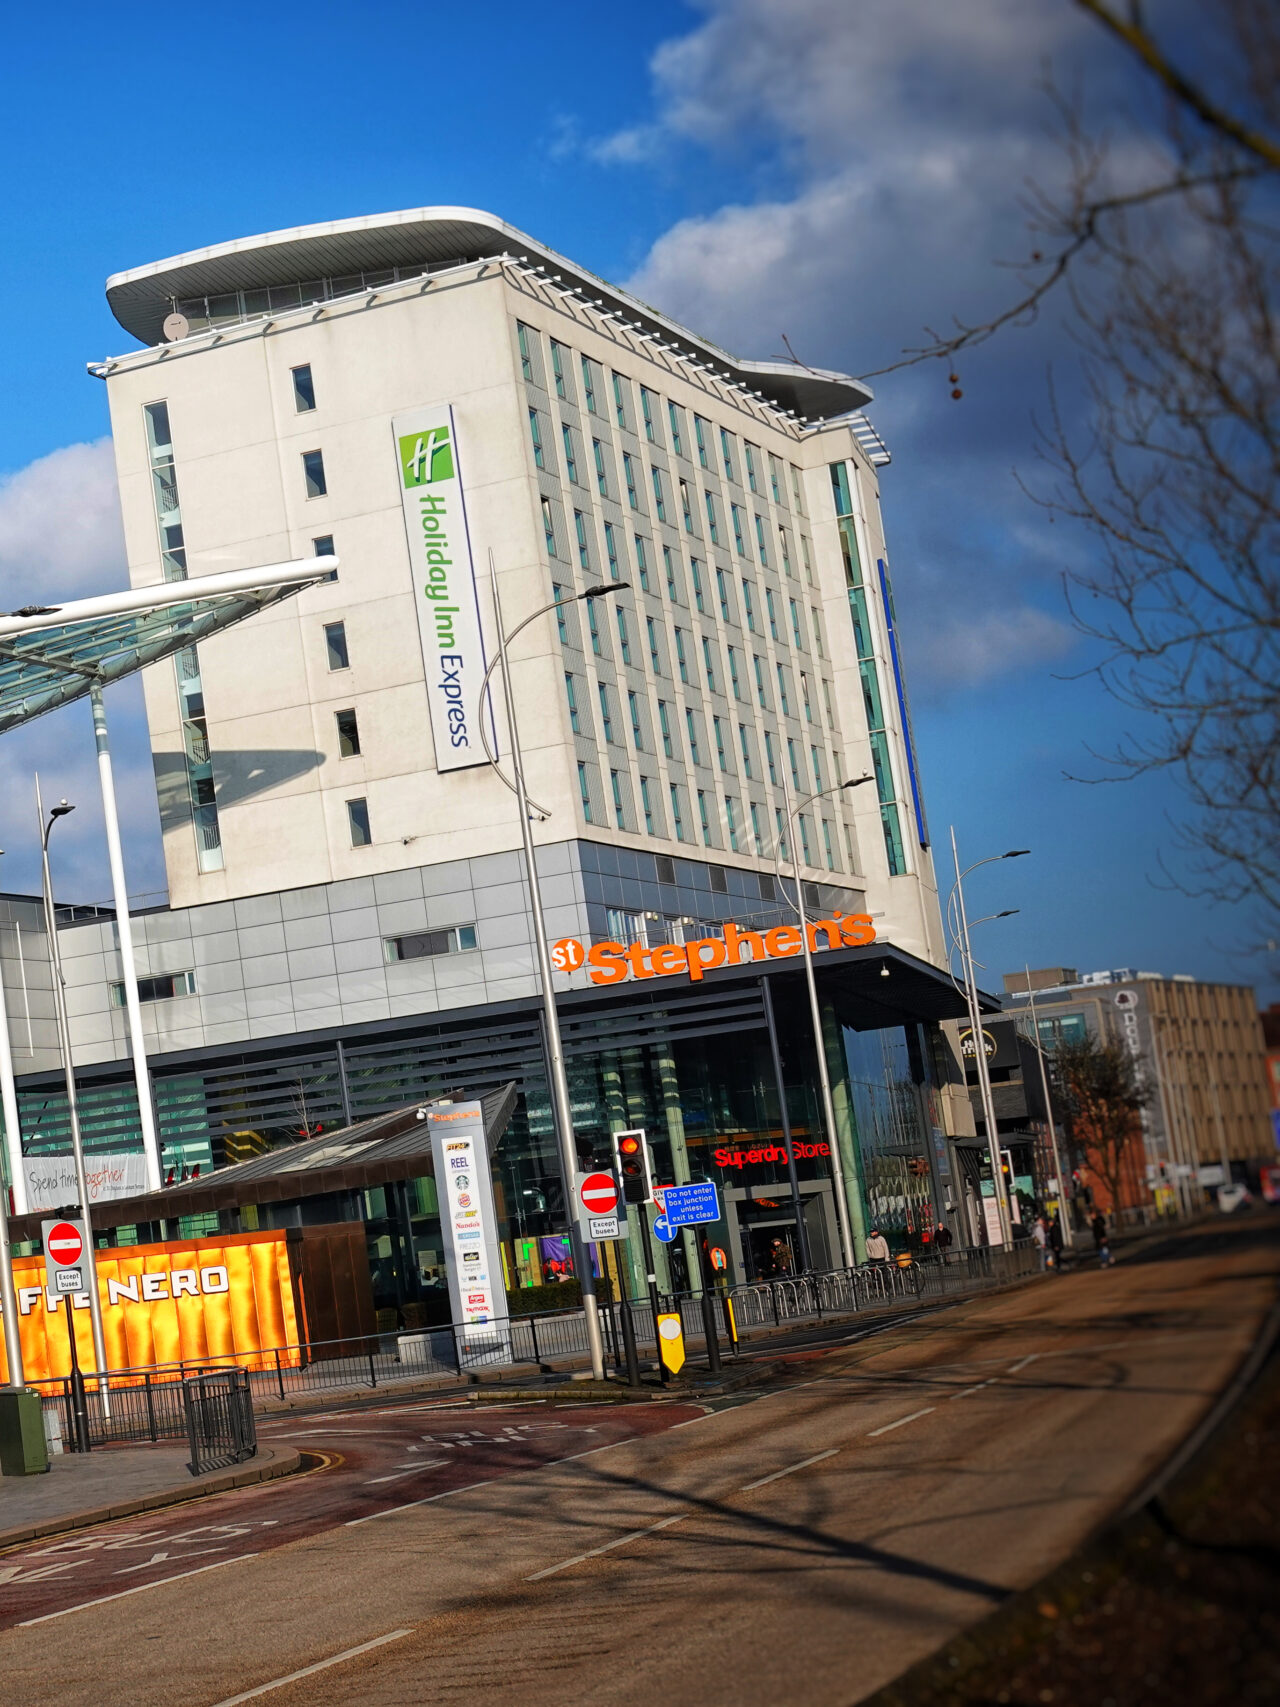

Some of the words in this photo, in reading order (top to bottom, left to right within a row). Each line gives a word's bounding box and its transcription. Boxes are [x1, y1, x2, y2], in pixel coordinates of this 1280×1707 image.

[419, 494, 453, 600] Holiday
[433, 605, 460, 648] Inn
[438, 655, 470, 748] Express
[450, 1157, 469, 1169] REEL
[714, 1143, 788, 1169] Superdry
[29, 1170, 58, 1200] Spend
[84, 1165, 125, 1198] ogether
[667, 1191, 678, 1199] Do
[679, 1189, 692, 1197] not
[693, 1187, 713, 1195] enter
[683, 1195, 713, 1206] junction
[672, 1214, 686, 1222] exit
[695, 1211, 714, 1219] clear
[680, 1205, 704, 1213] unless
[593, 1220, 616, 1228] Except
[595, 1227, 615, 1235] buses
[59, 1273, 79, 1281] Except
[107, 1265, 229, 1305] NERO
[421, 1422, 568, 1442] BUS
[24, 1521, 280, 1558] BUS
